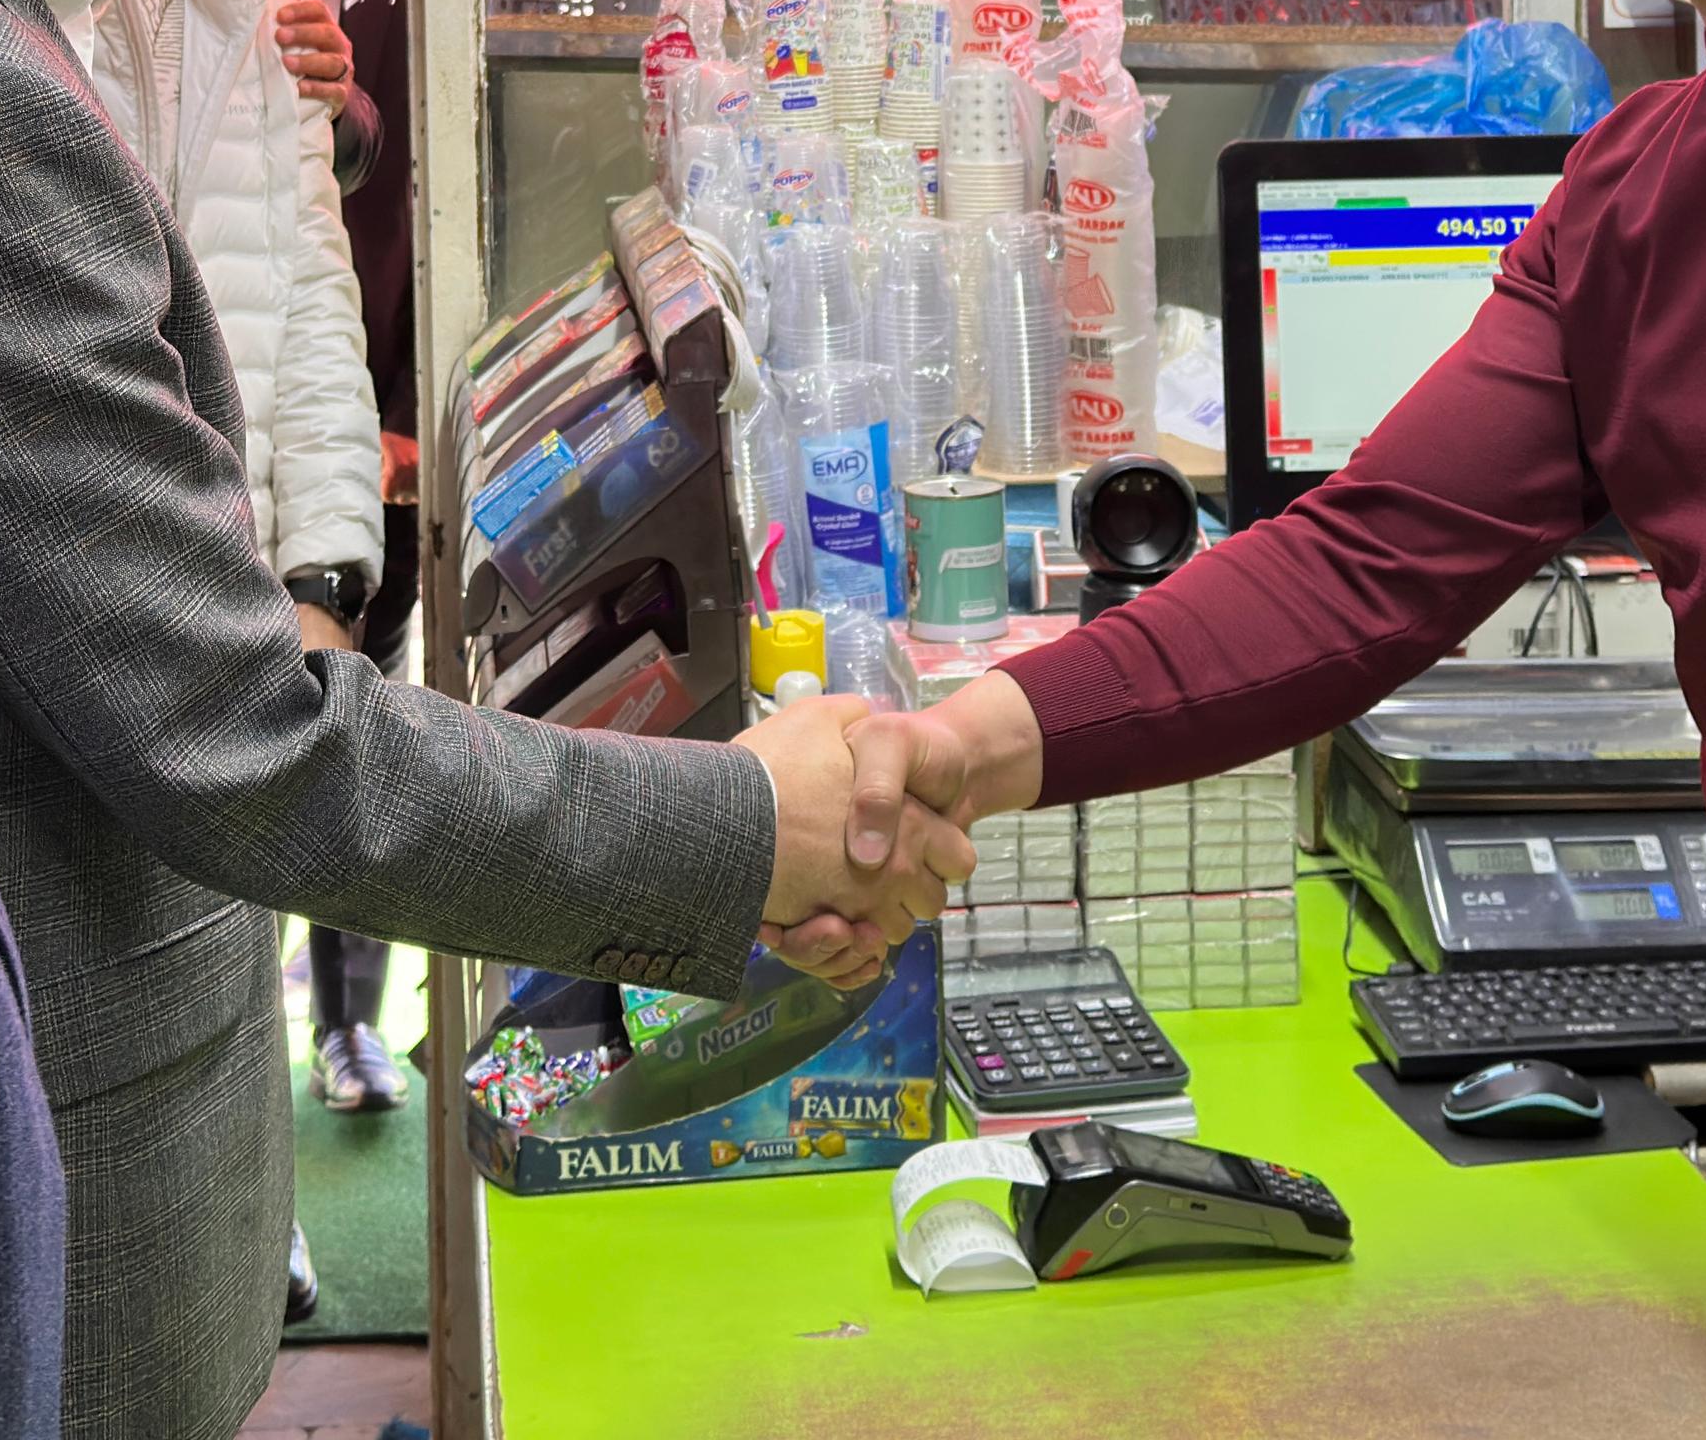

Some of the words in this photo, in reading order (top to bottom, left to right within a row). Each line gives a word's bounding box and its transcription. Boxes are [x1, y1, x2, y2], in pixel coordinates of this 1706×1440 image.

[772, 171, 815, 191] POPPY
[1436, 217, 1507, 239] 494,50
[811, 455, 861, 479] EMA
[1461, 890, 1507, 907] CAS
[696, 997, 781, 1064] Nazar
[800, 1092, 893, 1122] FALIM
[557, 1140, 684, 1182] FALIM
[753, 1140, 795, 1160] FALIM
